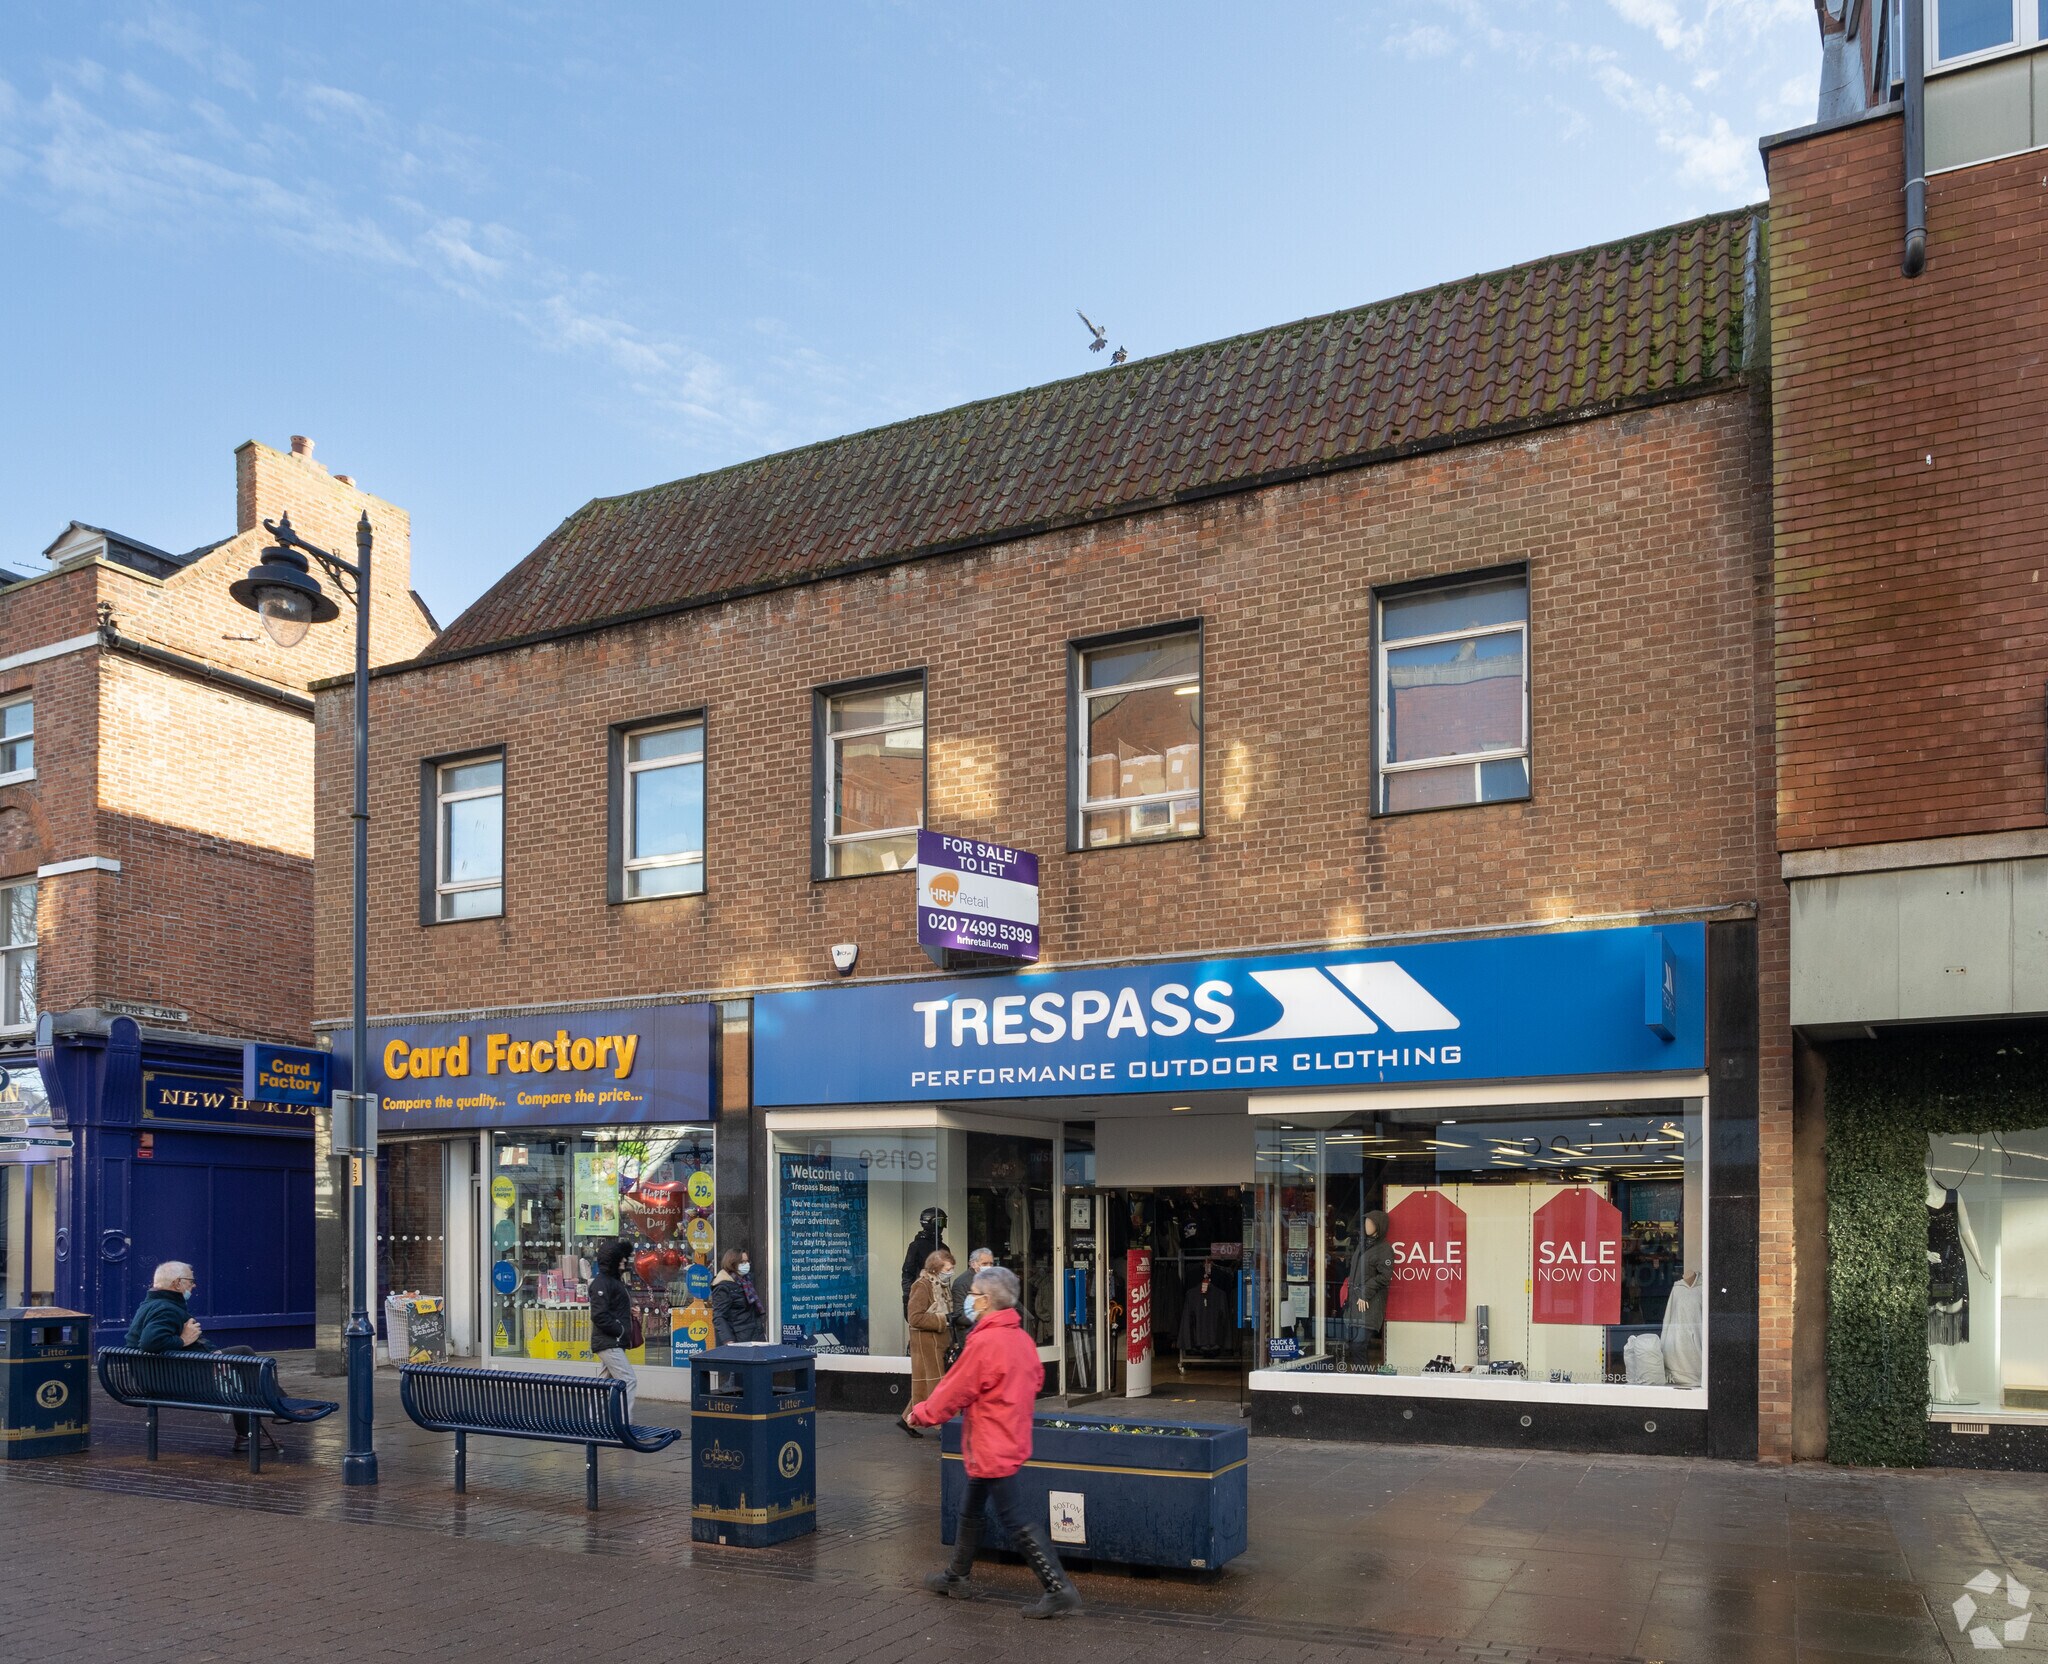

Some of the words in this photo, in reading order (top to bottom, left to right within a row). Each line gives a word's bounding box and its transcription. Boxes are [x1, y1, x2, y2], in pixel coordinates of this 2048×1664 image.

[943, 837, 973, 856] FOR
[977, 844, 1018, 865] SALE/
[958, 856, 977, 872] TO
[981, 862, 1005, 877] LET
[930, 887, 956, 902] HRH
[960, 892, 989, 908] Retail
[928, 913, 957, 931] 020
[961, 918, 997, 938] 7499
[1000, 925, 1033, 944] 5399
[957, 935, 1009, 951] hrhretail.com
[110, 1003, 145, 1016] MITRE
[152, 1009, 183, 1021] LANE
[913, 980, 1236, 1049] TRESPASS
[384, 1036, 471, 1080] Card
[487, 1030, 639, 1079] Factory
[272, 1059, 310, 1076] Card
[912, 1063, 1115, 1087] PERFORMANCE
[1129, 1055, 1278, 1079] OUTDOOR
[1293, 1046, 1462, 1071] CLOTHING
[260, 1073, 321, 1095] Factory
[159, 1089, 225, 1109] NEW
[383, 1097, 432, 1113] Compare
[435, 1094, 453, 1107] the
[456, 1094, 506, 1110] quality...
[517, 1091, 571, 1108] Compare
[575, 1089, 595, 1103] the
[599, 1088, 643, 1105] price...
[791, 1165, 841, 1180] Welcome
[844, 1170, 854, 1180] to
[642, 1189, 671, 1201] Happy
[695, 1186, 711, 1198] 29p
[792, 1183, 818, 1191] Trespass
[820, 1184, 840, 1192] Boston
[635, 1203, 681, 1215] Valentine's
[792, 1200, 811, 1208] You've
[647, 1218, 666, 1231] Day
[1392, 1242, 1461, 1264] SALE
[1539, 1242, 1615, 1264] SALE
[1392, 1268, 1431, 1281] NOW
[1436, 1268, 1462, 1281] ON
[1539, 1268, 1582, 1282] NOW
[1588, 1268, 1615, 1282] ON
[1131, 1279, 1150, 1303] SALE
[1131, 1300, 1150, 1324] SALE
[414, 1326, 438, 1336] School
[1131, 1319, 1150, 1344] SALE
[41, 1349, 69, 1357] Litter
[557, 1351, 572, 1359] 99p
[580, 1351, 594, 1359] 99p
[1305, 1362, 1334, 1371] online
[1337, 1362, 1347, 1372] @
[708, 1400, 735, 1412] Litter
[780, 1400, 800, 1411] Litter
[1053, 1502, 1082, 1514] BOSTON
[1054, 1521, 1061, 1529] IN
[1062, 1524, 1081, 1533] BLOOM
